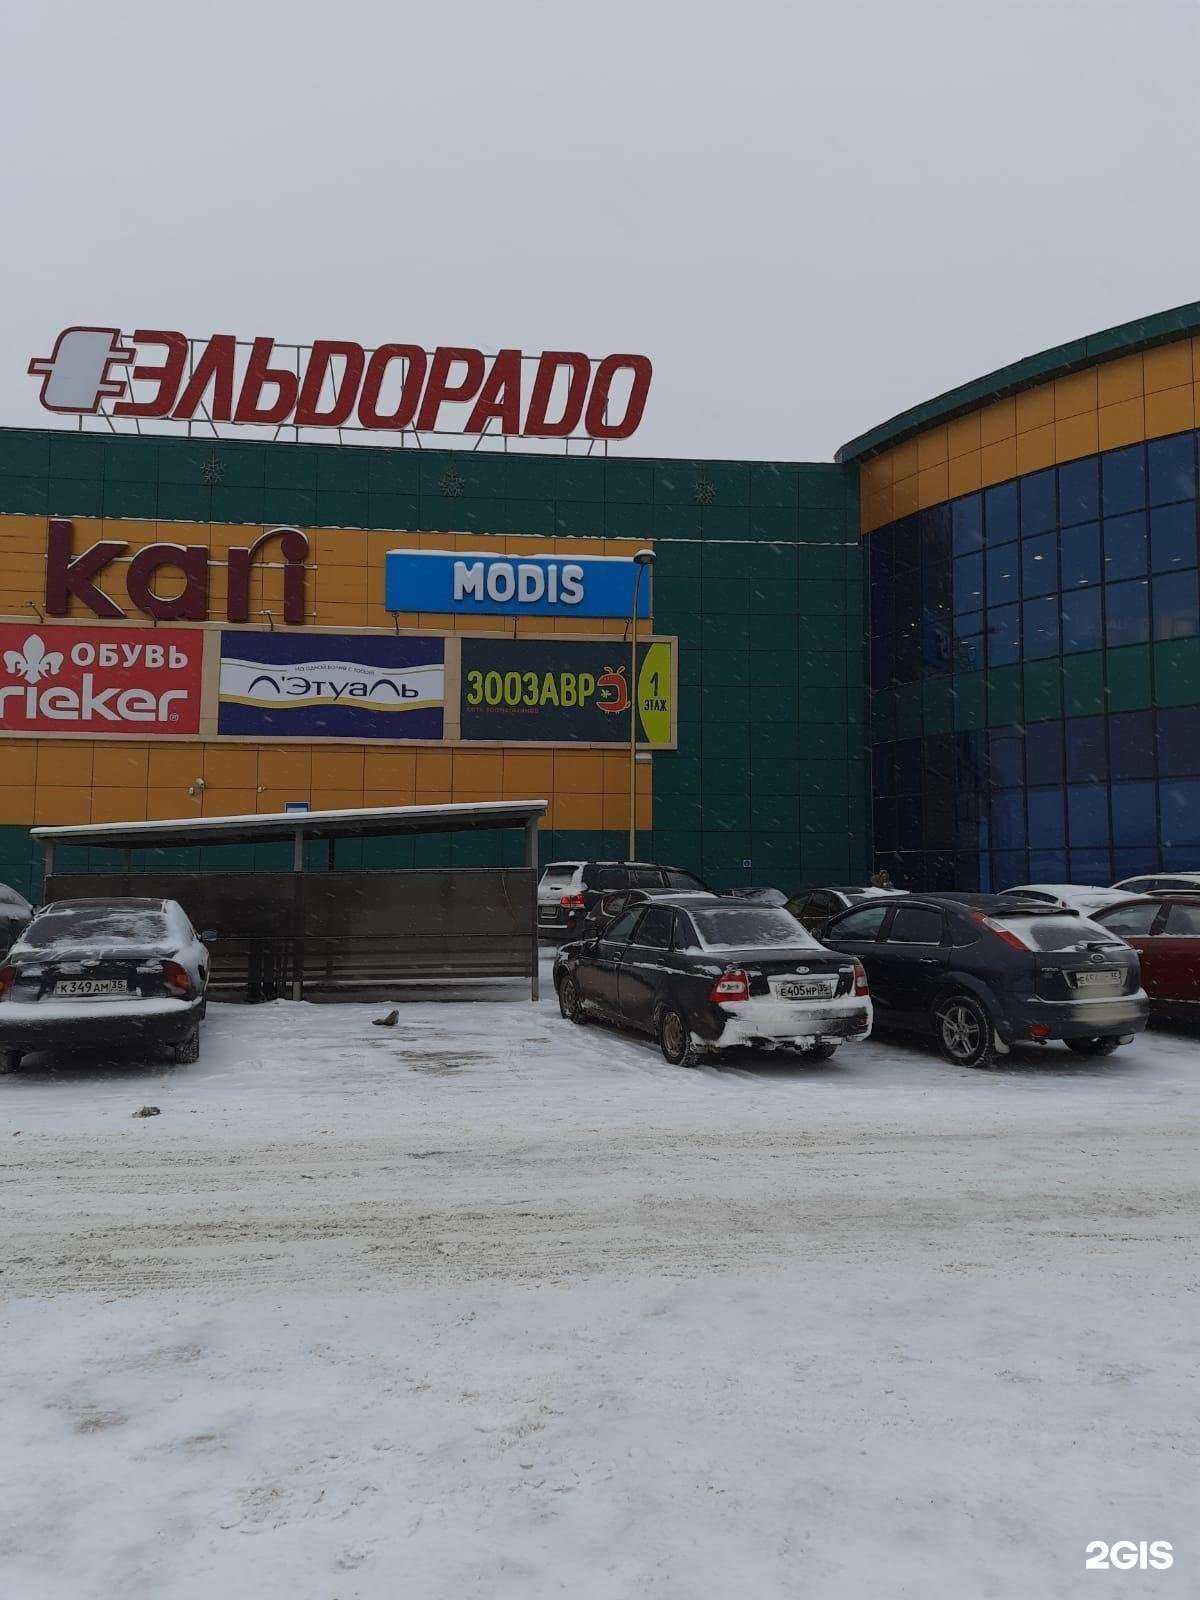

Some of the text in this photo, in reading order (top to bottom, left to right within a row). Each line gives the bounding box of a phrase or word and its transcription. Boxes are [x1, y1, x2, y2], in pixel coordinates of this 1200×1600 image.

[453, 561, 585, 604] MODIS
[70, 642, 189, 669] ОБУВЬ
[0, 673, 188, 722] rieker
[466, 670, 596, 707] ЗООЗАВР
[650, 671, 660, 697] 1
[643, 698, 668, 713] ЭТАЖ
